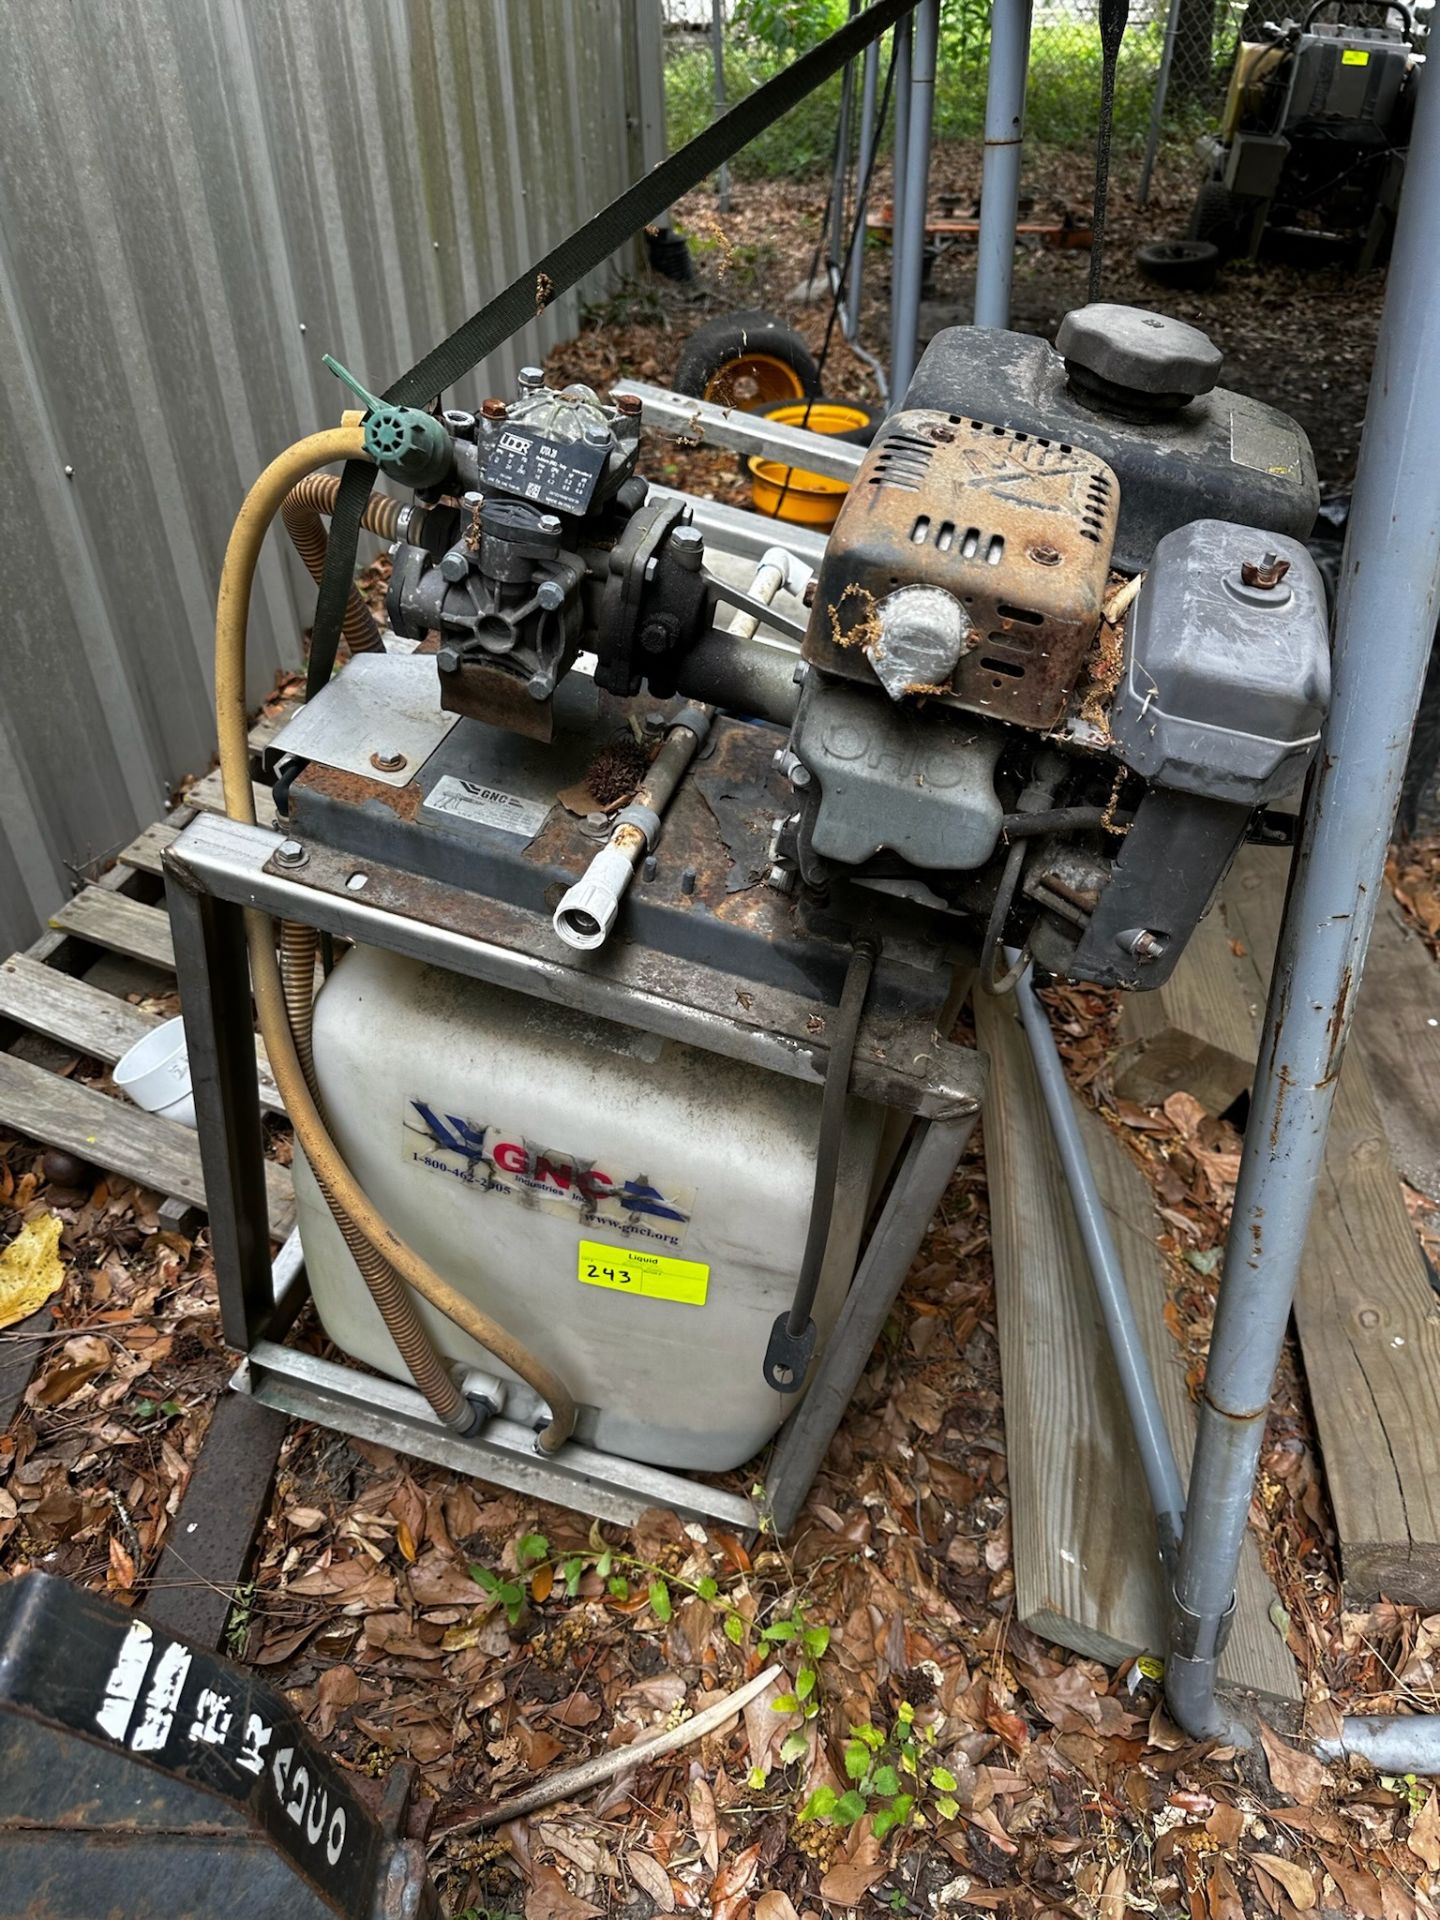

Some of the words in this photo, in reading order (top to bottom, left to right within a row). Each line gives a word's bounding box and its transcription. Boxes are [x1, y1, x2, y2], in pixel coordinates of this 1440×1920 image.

[499, 432, 534, 456] UDOR
[480, 789, 508, 804] GNC
[493, 1142, 613, 1200] GNC
[515, 1175, 564, 1196] Industries
[628, 1253, 659, 1265] Liquid
[587, 1264, 631, 1284] 243
